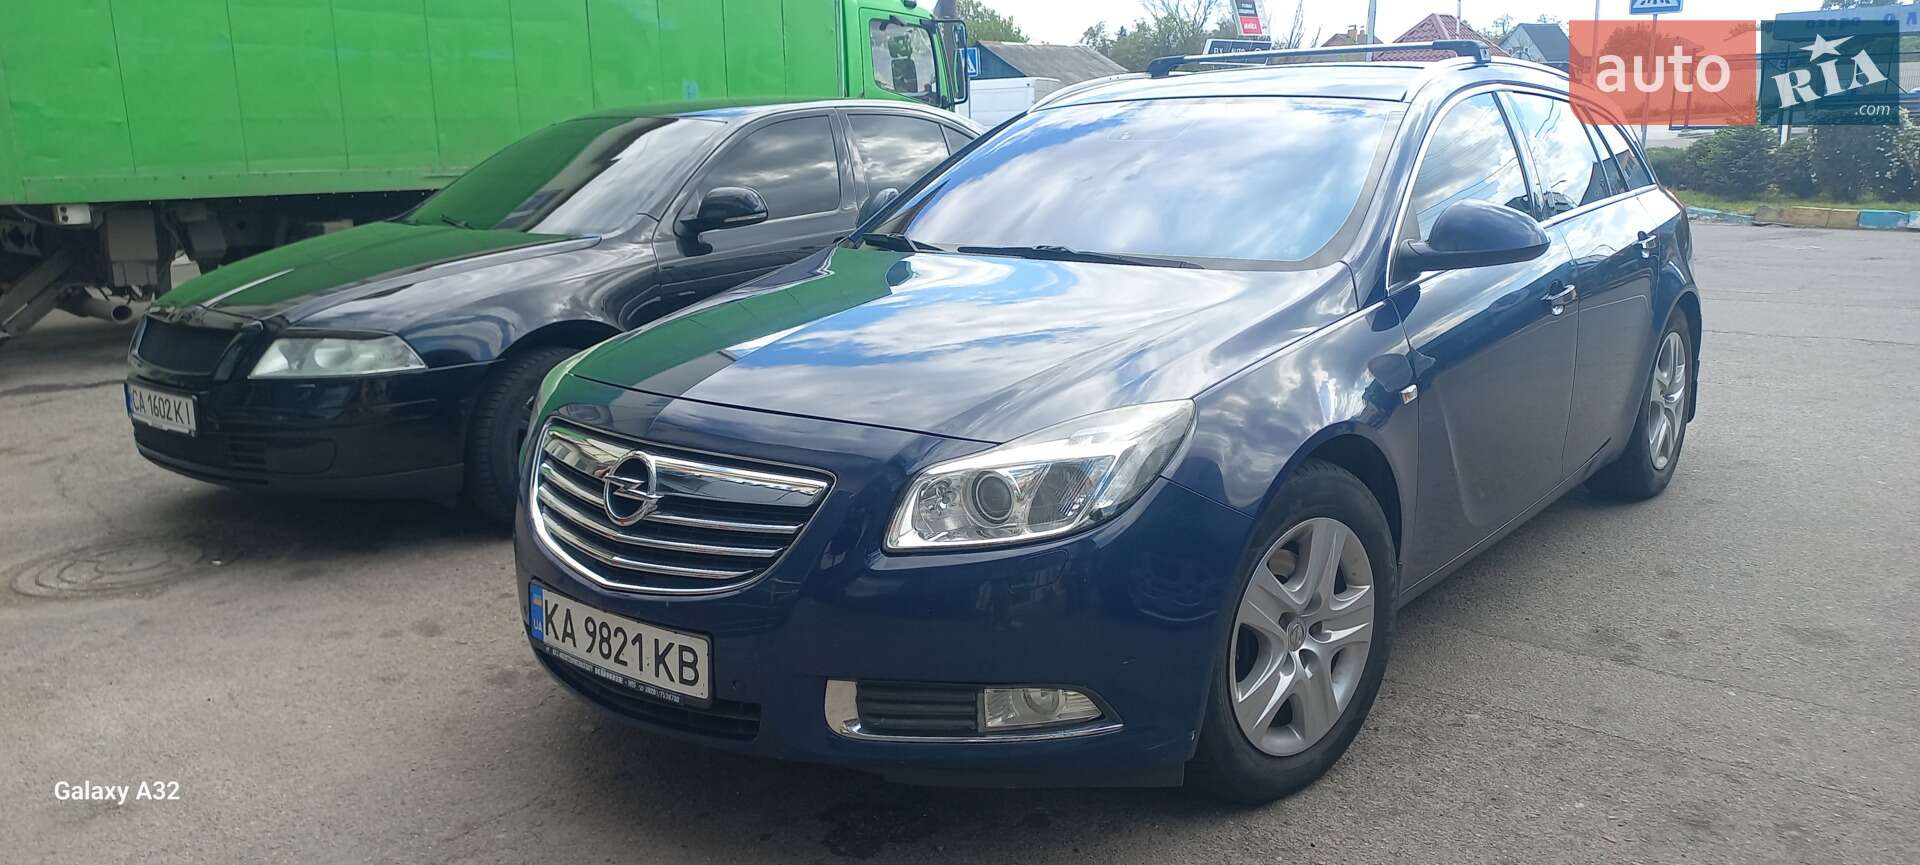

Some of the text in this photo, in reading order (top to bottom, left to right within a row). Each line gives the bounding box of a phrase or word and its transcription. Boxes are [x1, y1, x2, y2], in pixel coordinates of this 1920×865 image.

[132, 389, 146, 413] CA
[148, 394, 173, 421] 1602
[533, 618, 543, 633] UA
[544, 599, 577, 648] KA
[584, 616, 643, 672] 9821
[654, 638, 700, 686] KB
